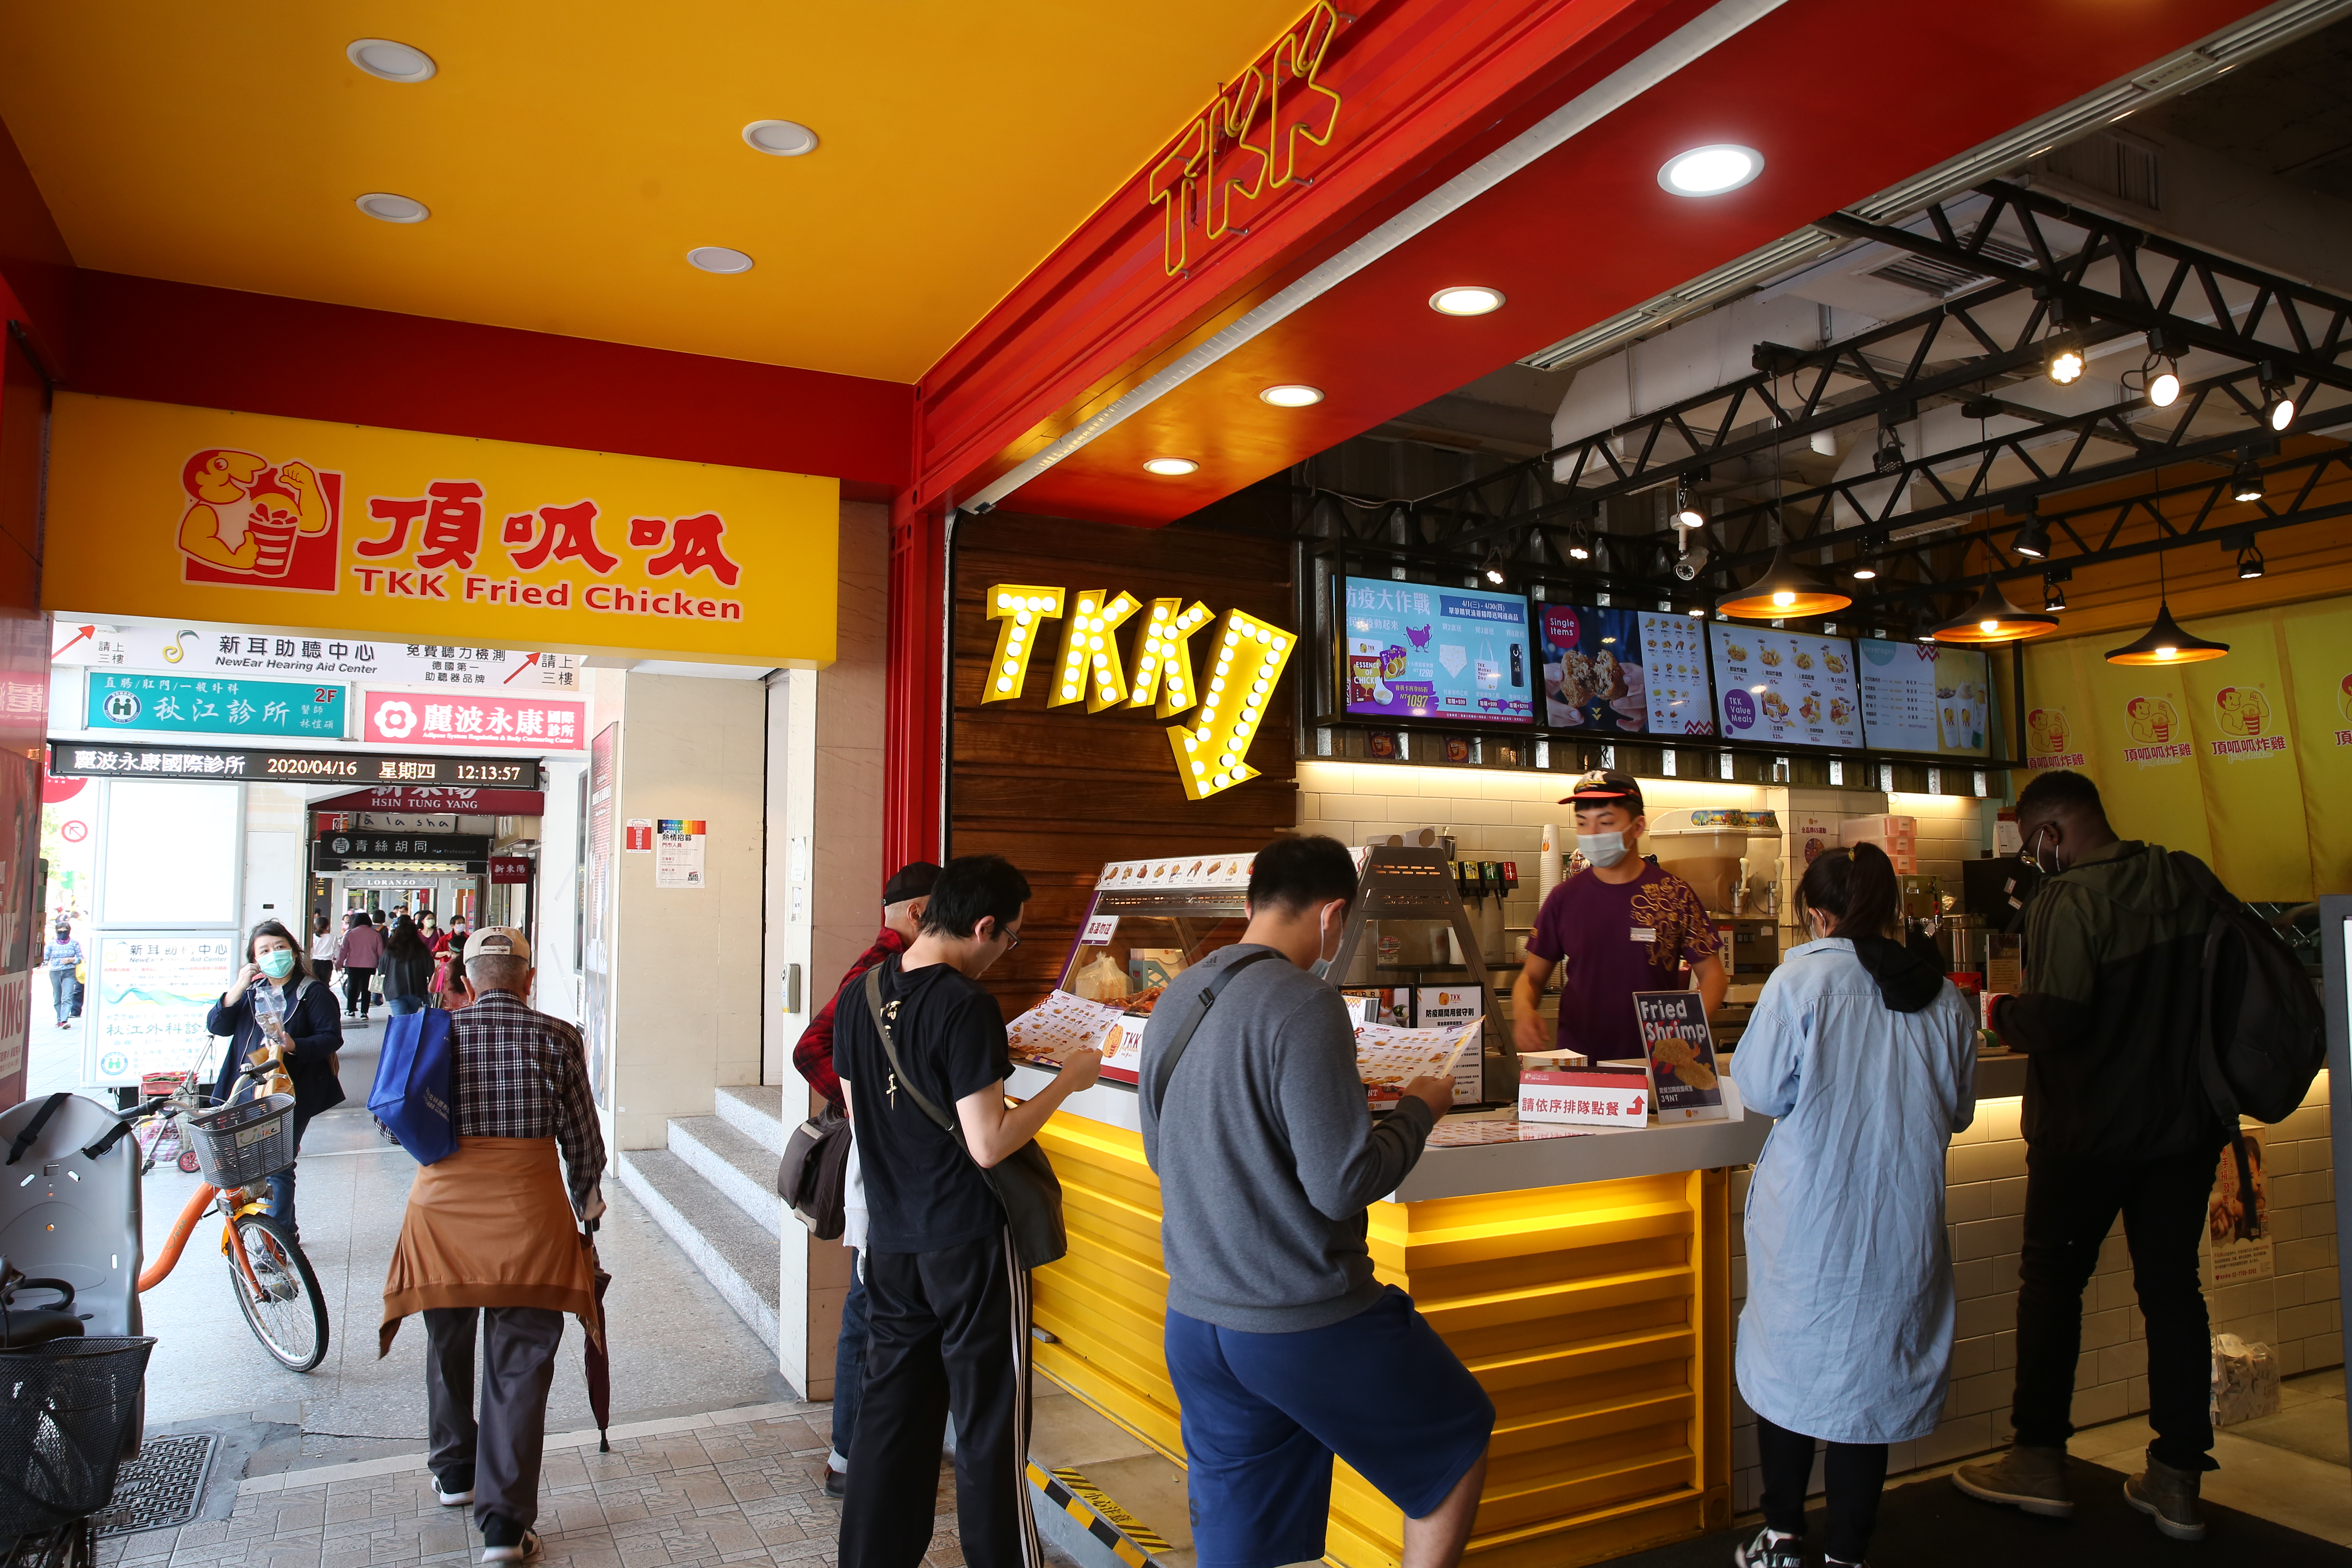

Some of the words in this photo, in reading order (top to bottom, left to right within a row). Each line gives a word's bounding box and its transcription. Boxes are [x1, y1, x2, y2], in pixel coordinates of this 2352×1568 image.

[1149, 0, 1342, 276] TKK
[356, 481, 740, 586] 頂呱呱
[354, 568, 445, 598] TKK
[466, 576, 569, 607] Fried
[584, 587, 740, 620] Chicken
[1550, 618, 1575, 628] Single
[1550, 627, 1574, 636] Items
[98, 641, 125, 652] 請上
[219, 635, 375, 662] 新耳助聽中心
[981, 584, 1216, 719] TKK
[98, 654, 124, 664] 三樓
[215, 656, 264, 668] NewEar
[266, 659, 313, 672] Hearing
[316, 662, 335, 672] Aid
[339, 663, 378, 674] Center
[431, 661, 480, 671] 德國第一
[541, 654, 574, 669] 請上
[425, 672, 486, 684] 助聽器品牌
[541, 671, 573, 686] 三樓
[1419, 668, 1433, 677] 1290
[314, 687, 338, 703] 2F
[1407, 694, 1429, 708] 1097
[1729, 697, 1742, 706] TKK
[153, 695, 290, 728] 秋江診所
[547, 710, 575, 724] 國際
[1730, 706, 1751, 715] Value
[422, 703, 544, 736] 麗波永康
[1731, 714, 1753, 723] Meals
[547, 724, 575, 738] 診所
[521, 736, 555, 744] Contouring
[74, 750, 246, 775] 麗波永康國際診所
[267, 758, 357, 776] 2020/04/16
[378, 762, 437, 780] 星期四
[457, 765, 521, 781] 12:13:57
[372, 798, 401, 807] HSIN
[408, 799, 441, 808] TUNG
[445, 800, 478, 809] YANG
[416, 818, 450, 828] sha
[355, 840, 428, 853] 青絲胡同
[494, 864, 526, 873] 新東陽
[1425, 1008, 1474, 1018] 防疫期間用餐守則
[1640, 1000, 1688, 1020] Fried
[1645, 1021, 1706, 1044] Shrimp
[1123, 1031, 1142, 1049] TKK
[1661, 1094, 1678, 1102] 39NT
[1521, 1097, 1619, 1116] 請依序排隊點餐
[1083, 1492, 1133, 1523] 小心注意
